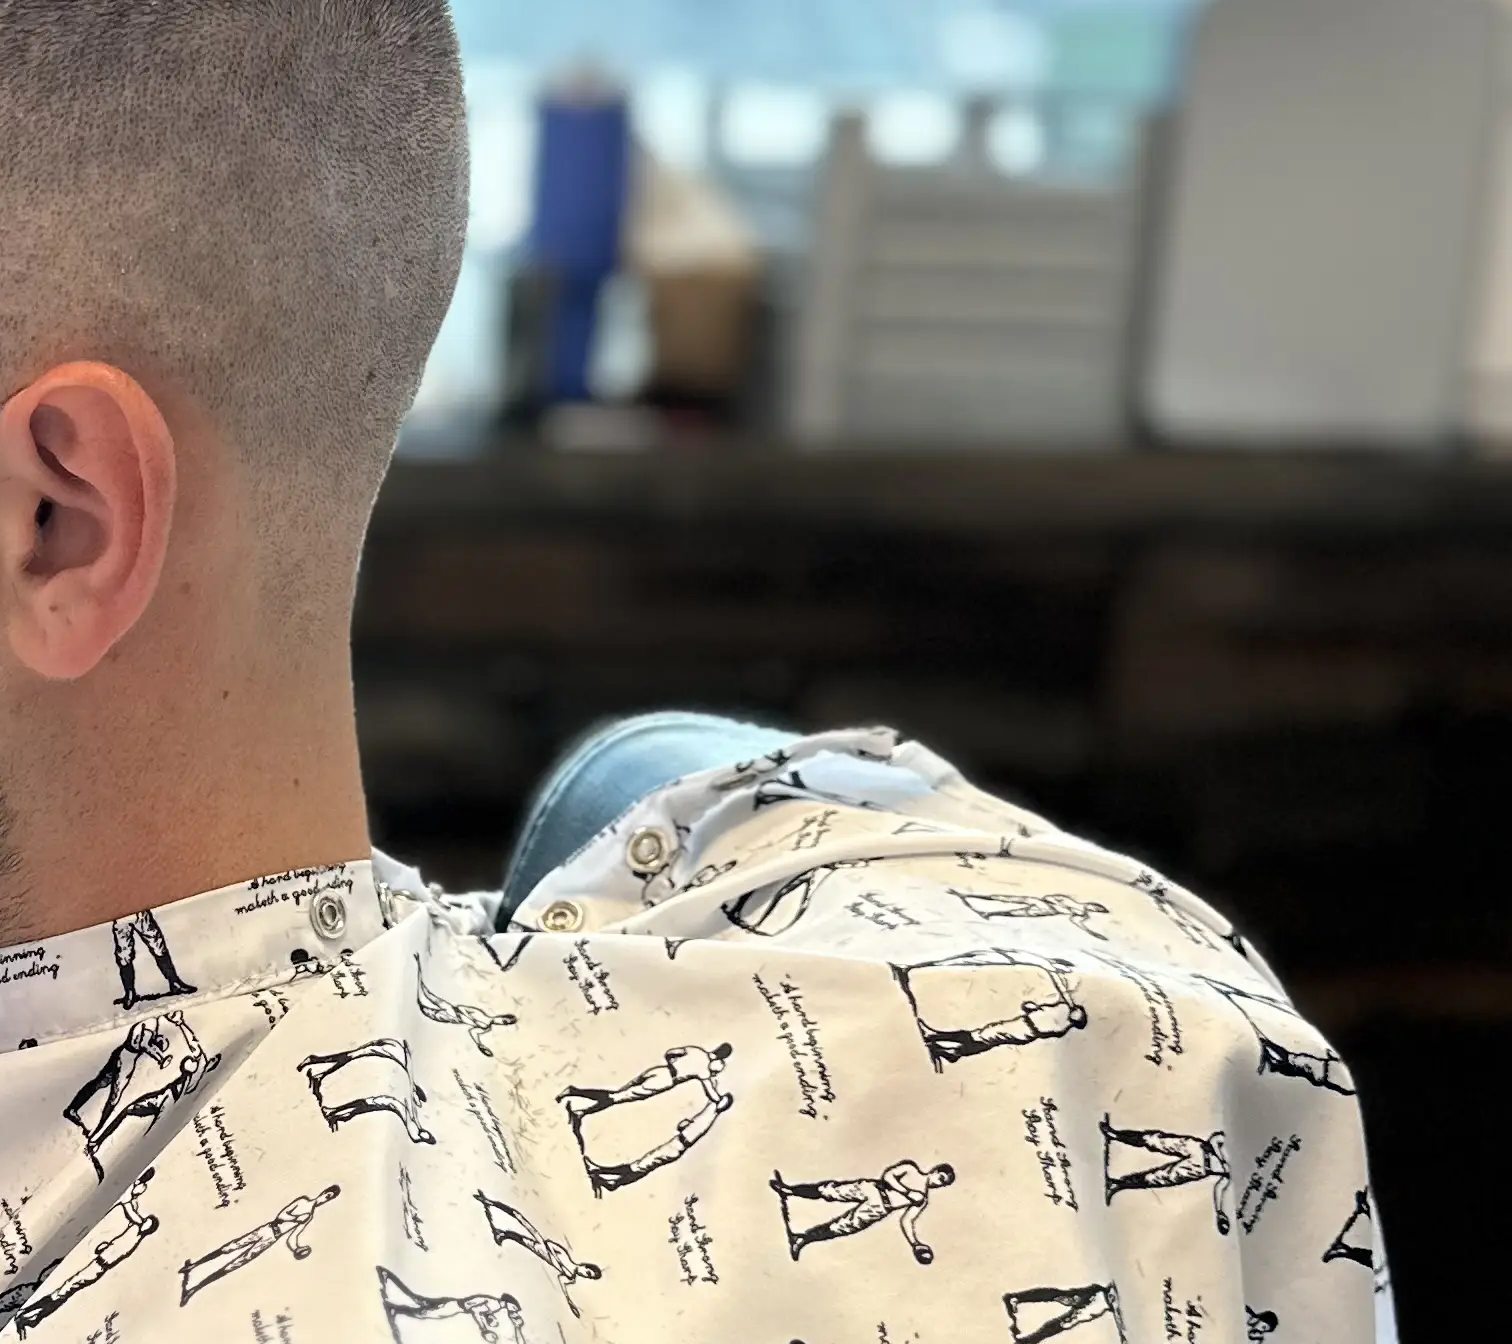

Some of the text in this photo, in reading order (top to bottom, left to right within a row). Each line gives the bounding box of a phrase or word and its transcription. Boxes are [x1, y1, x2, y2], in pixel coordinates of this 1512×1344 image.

[280, 892, 290, 902] a
[291, 878, 326, 907] good
[12, 959, 60, 981] ending
[779, 1021, 790, 1031] a
[787, 995, 818, 1029] hard
[775, 1031, 809, 1060] good
[802, 1028, 837, 1104] beginning
[793, 1061, 824, 1120] ending
[211, 1112, 234, 1142] hard
[195, 1147, 226, 1172] good
[219, 1139, 247, 1191] beginning
[1036, 1150, 1071, 1206] Sharp
[1162, 1277, 1183, 1341] maketh
